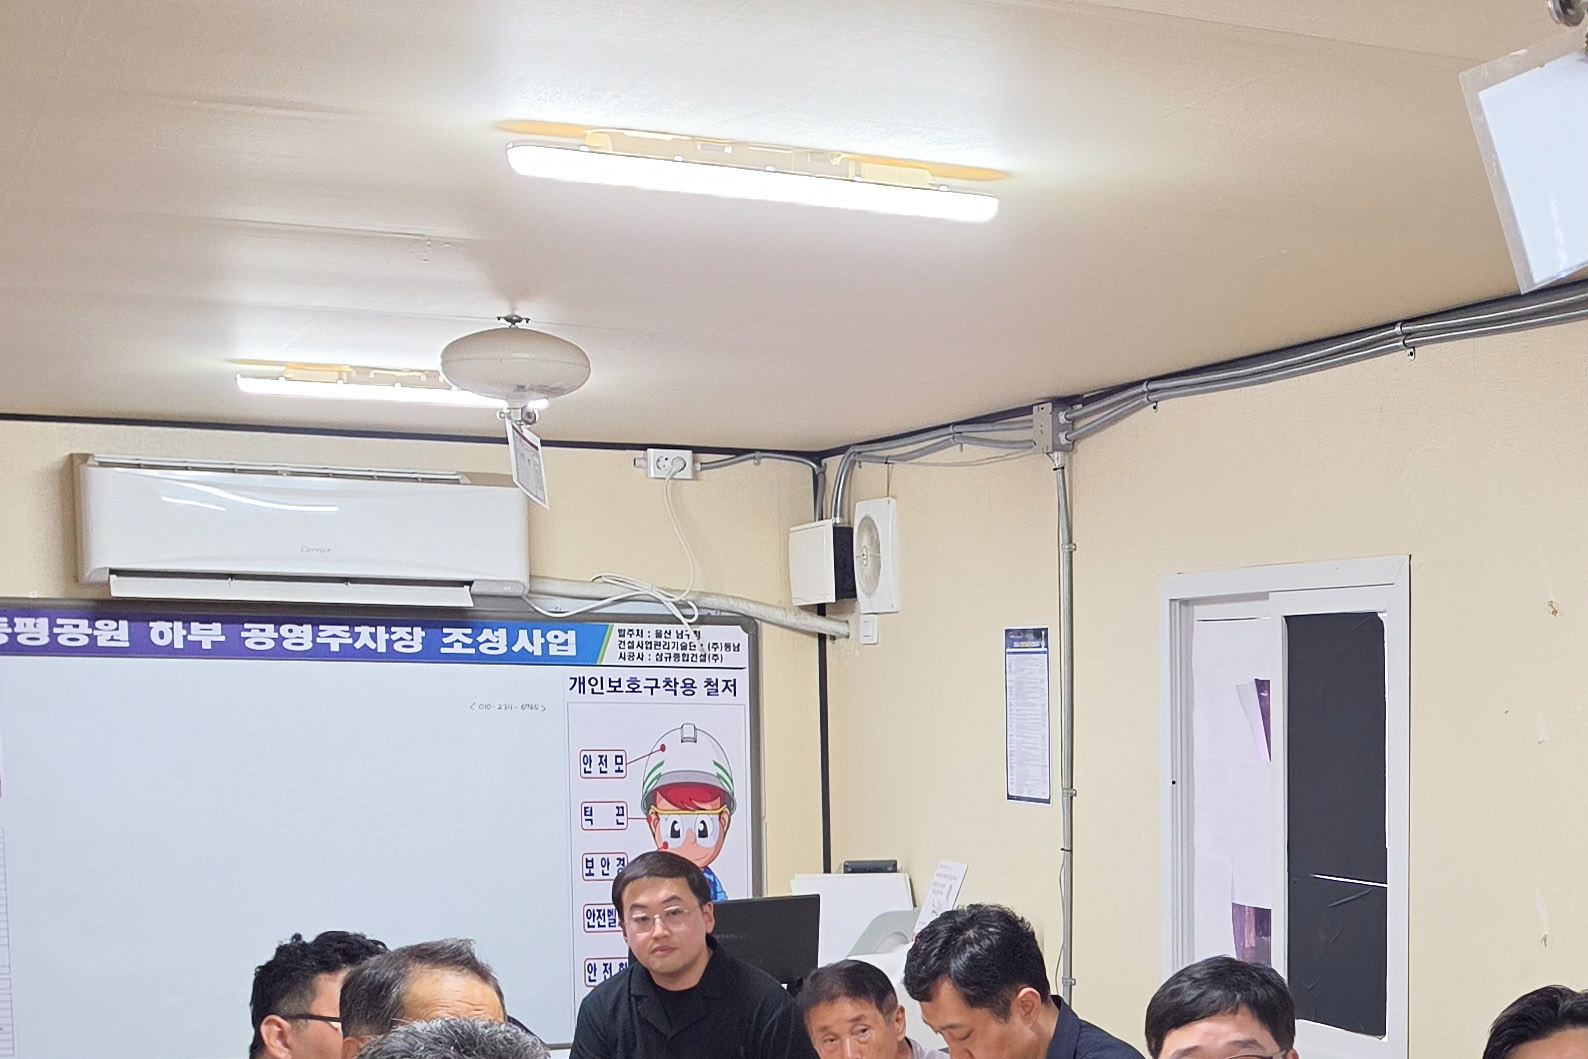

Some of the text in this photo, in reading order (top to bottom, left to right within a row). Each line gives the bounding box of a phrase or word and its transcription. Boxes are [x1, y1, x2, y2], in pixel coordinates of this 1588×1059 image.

[149, 620, 226, 650] 하부
[241, 622, 426, 654] 공영주차장
[440, 626, 578, 657] 조성사업
[618, 629, 644, 639] 발주처
[655, 629, 672, 639] 울산
[708, 642, 741, 652] (주)동남
[618, 652, 644, 662] 시공사
[569, 676, 737, 697] 개인보호구착용 철저
[586, 908, 622, 928] 안전벨
